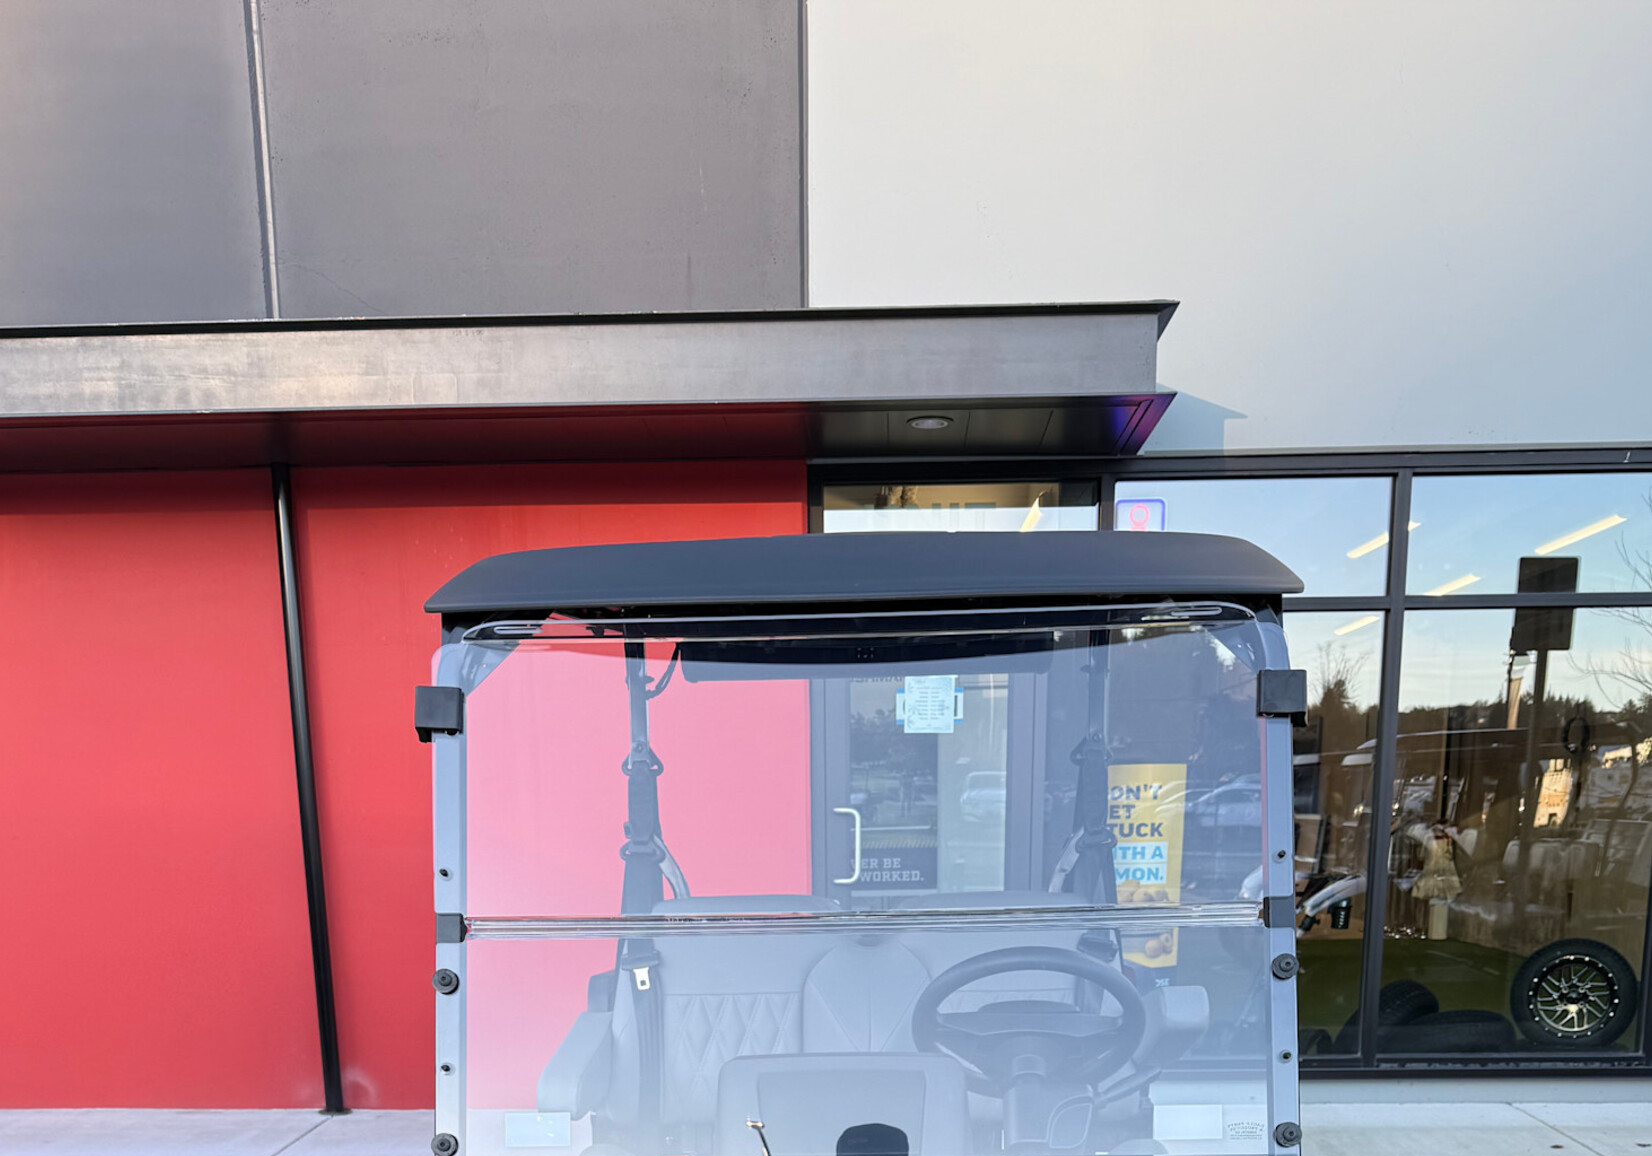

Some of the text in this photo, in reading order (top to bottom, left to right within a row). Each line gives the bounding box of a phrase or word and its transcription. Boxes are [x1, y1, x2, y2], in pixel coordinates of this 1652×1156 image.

[1110, 784, 1162, 800] ON'T
[1109, 804, 1136, 819] ET
[1107, 823, 1164, 837] TUCK
[1113, 846, 1164, 860] ITH A
[883, 858, 901, 868] BE
[860, 871, 924, 882] WORKED.
[1115, 867, 1164, 881] MON.
